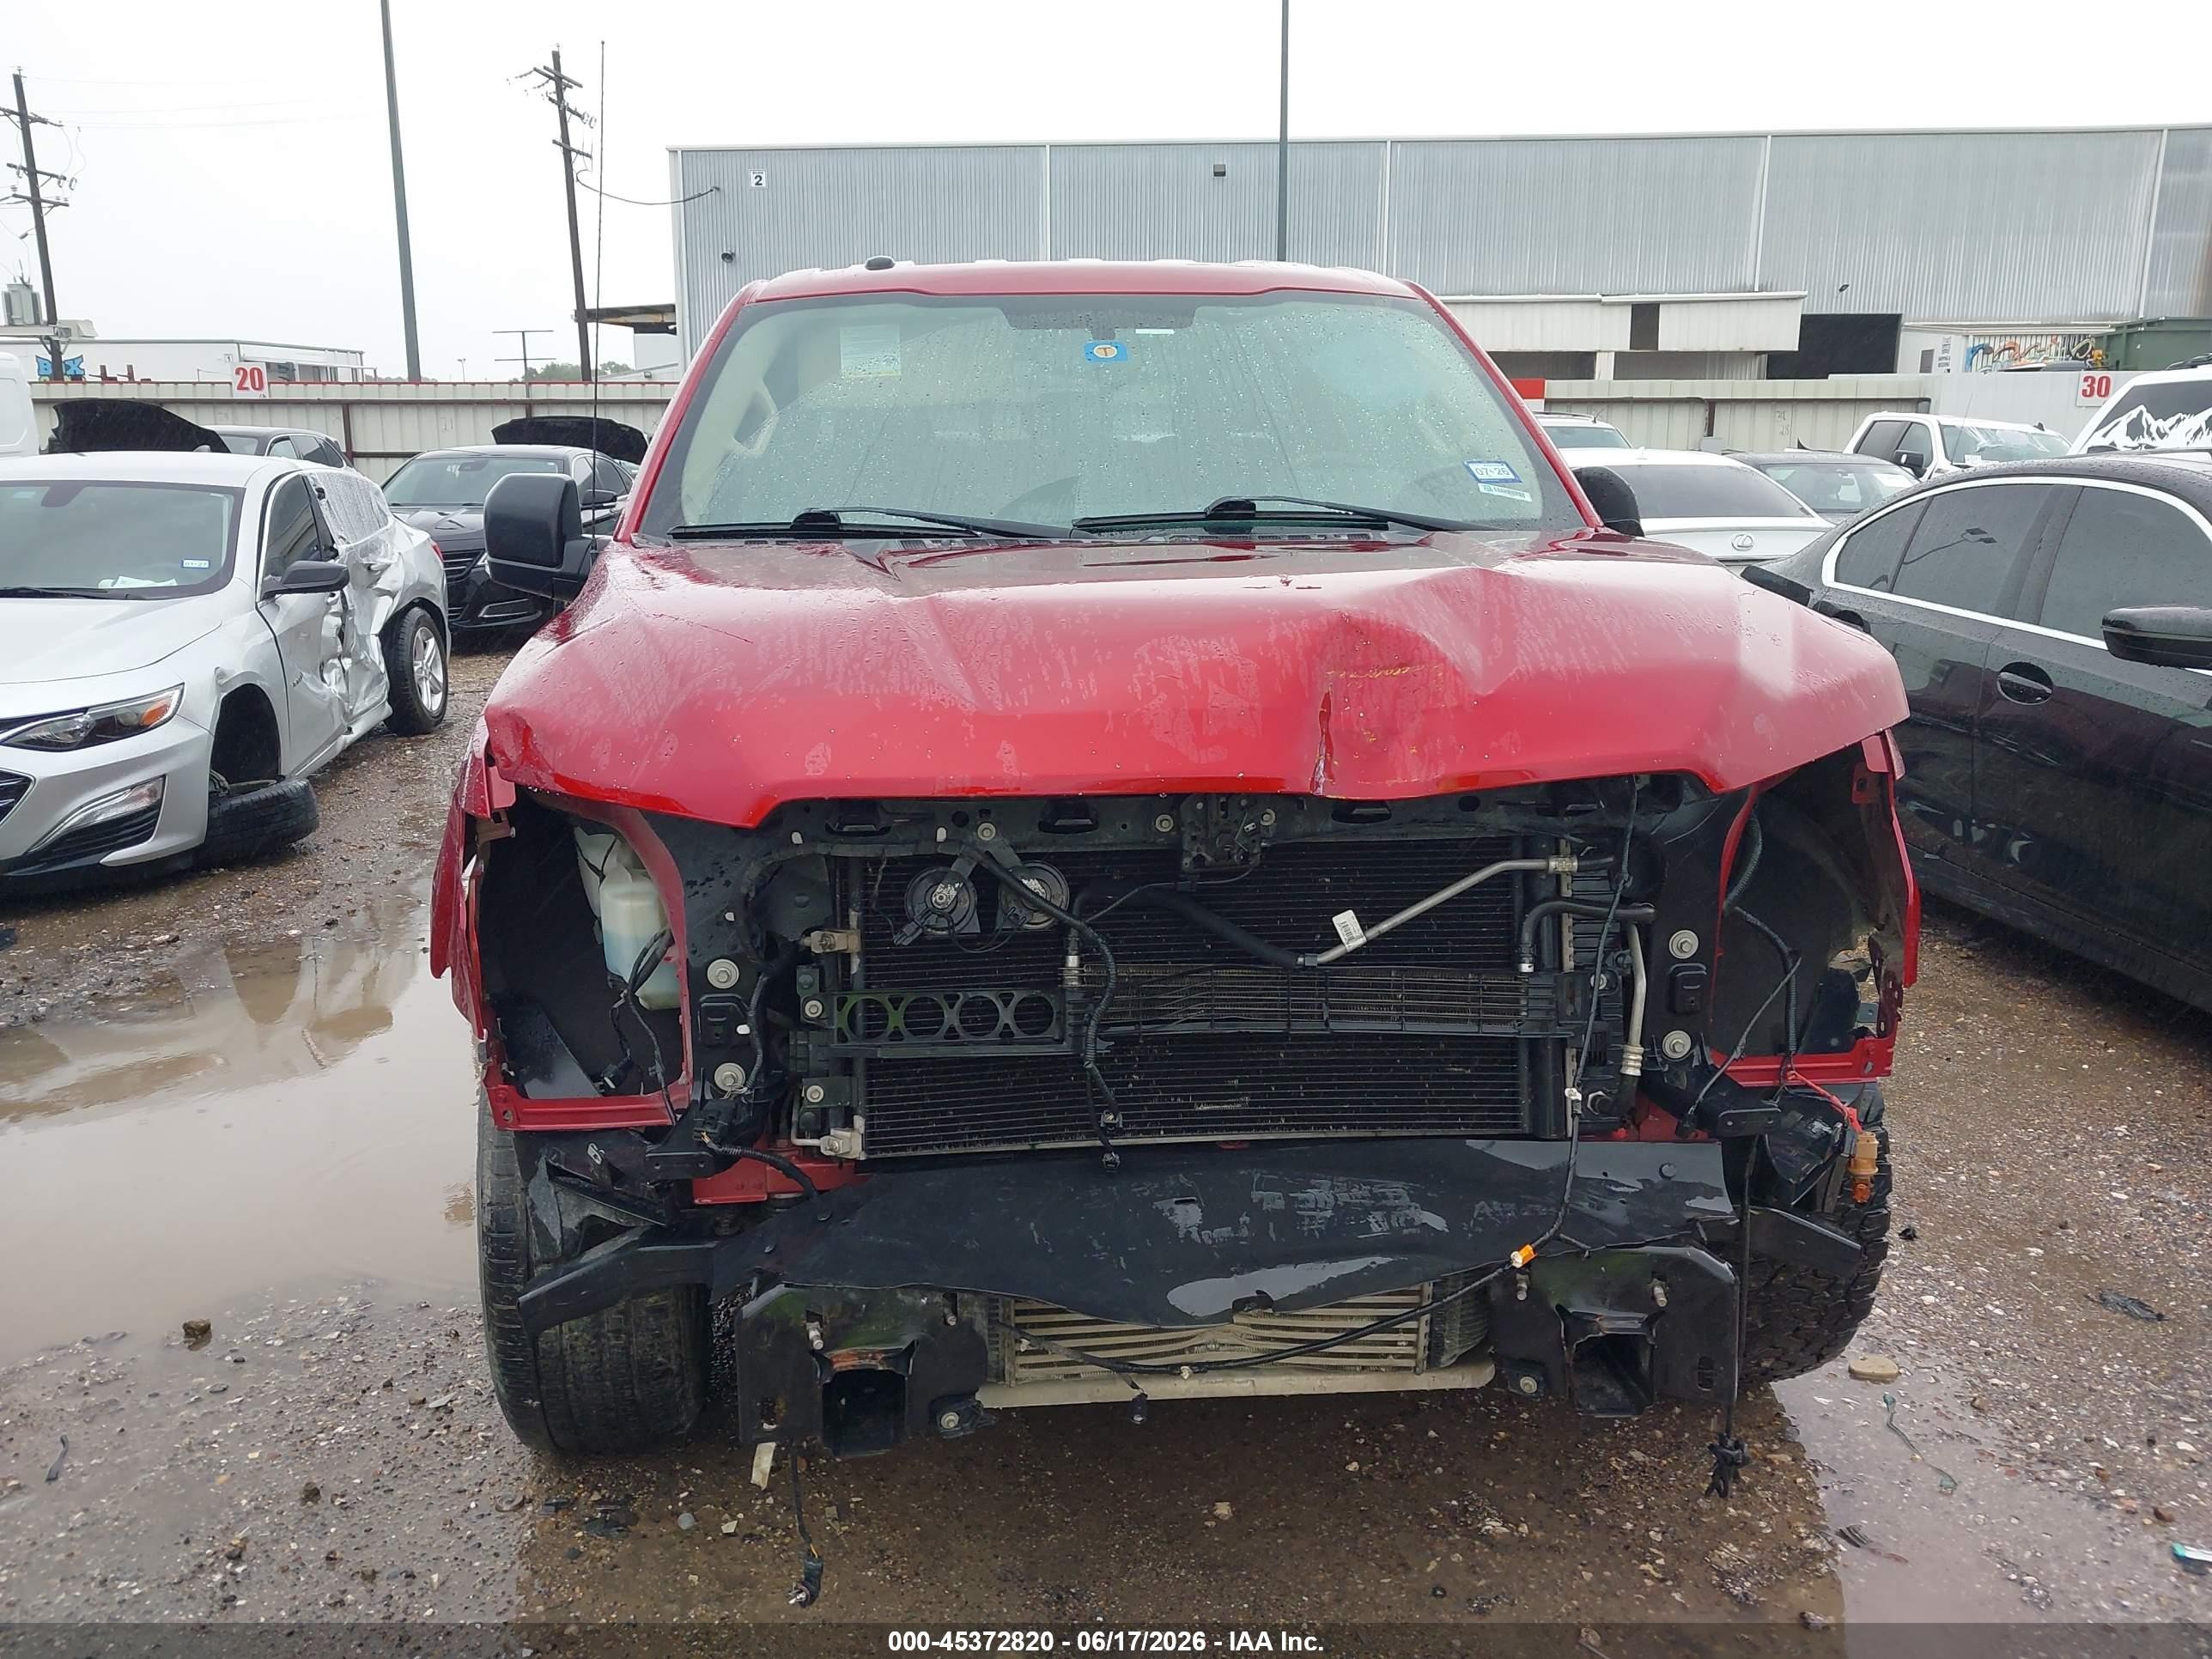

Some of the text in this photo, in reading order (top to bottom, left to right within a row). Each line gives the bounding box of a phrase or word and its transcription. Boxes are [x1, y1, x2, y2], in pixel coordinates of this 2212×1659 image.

[754, 174, 763, 186] 2
[35, 355, 85, 376] BX
[234, 367, 264, 391] 20
[2081, 375, 2111, 398] 30
